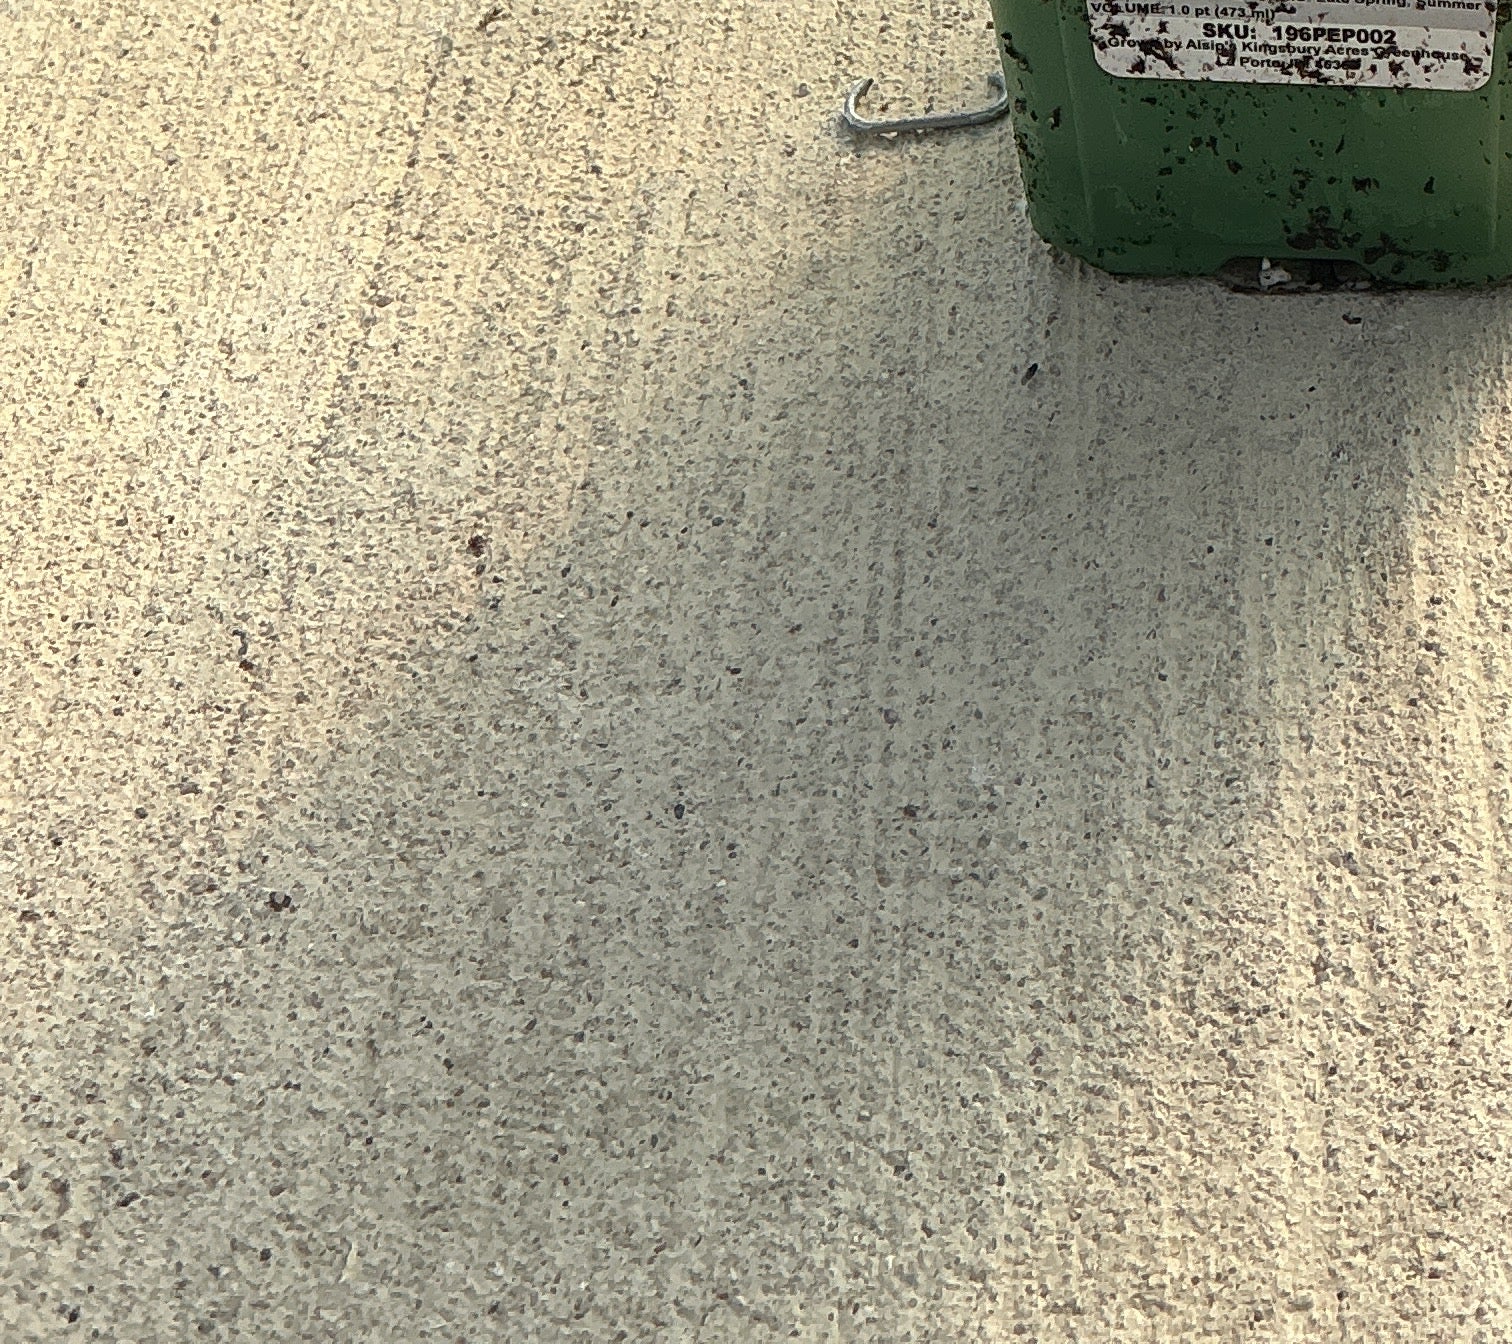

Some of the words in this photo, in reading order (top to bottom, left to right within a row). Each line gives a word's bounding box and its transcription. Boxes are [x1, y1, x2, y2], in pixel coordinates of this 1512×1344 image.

[1168, 4, 1190, 16] 1.0
[1195, 6, 1211, 18] pt
[1214, 4, 1246, 19] (473
[1202, 22, 1257, 40] SKU:
[1271, 24, 1397, 45] 196PEP002
[1107, 38, 1160, 49] Gro
[1164, 37, 1182, 52] by
[1186, 39, 1232, 52] Alsip'
[1323, 45, 1369, 57] Acres
[1374, 47, 1471, 62] Geehouse
